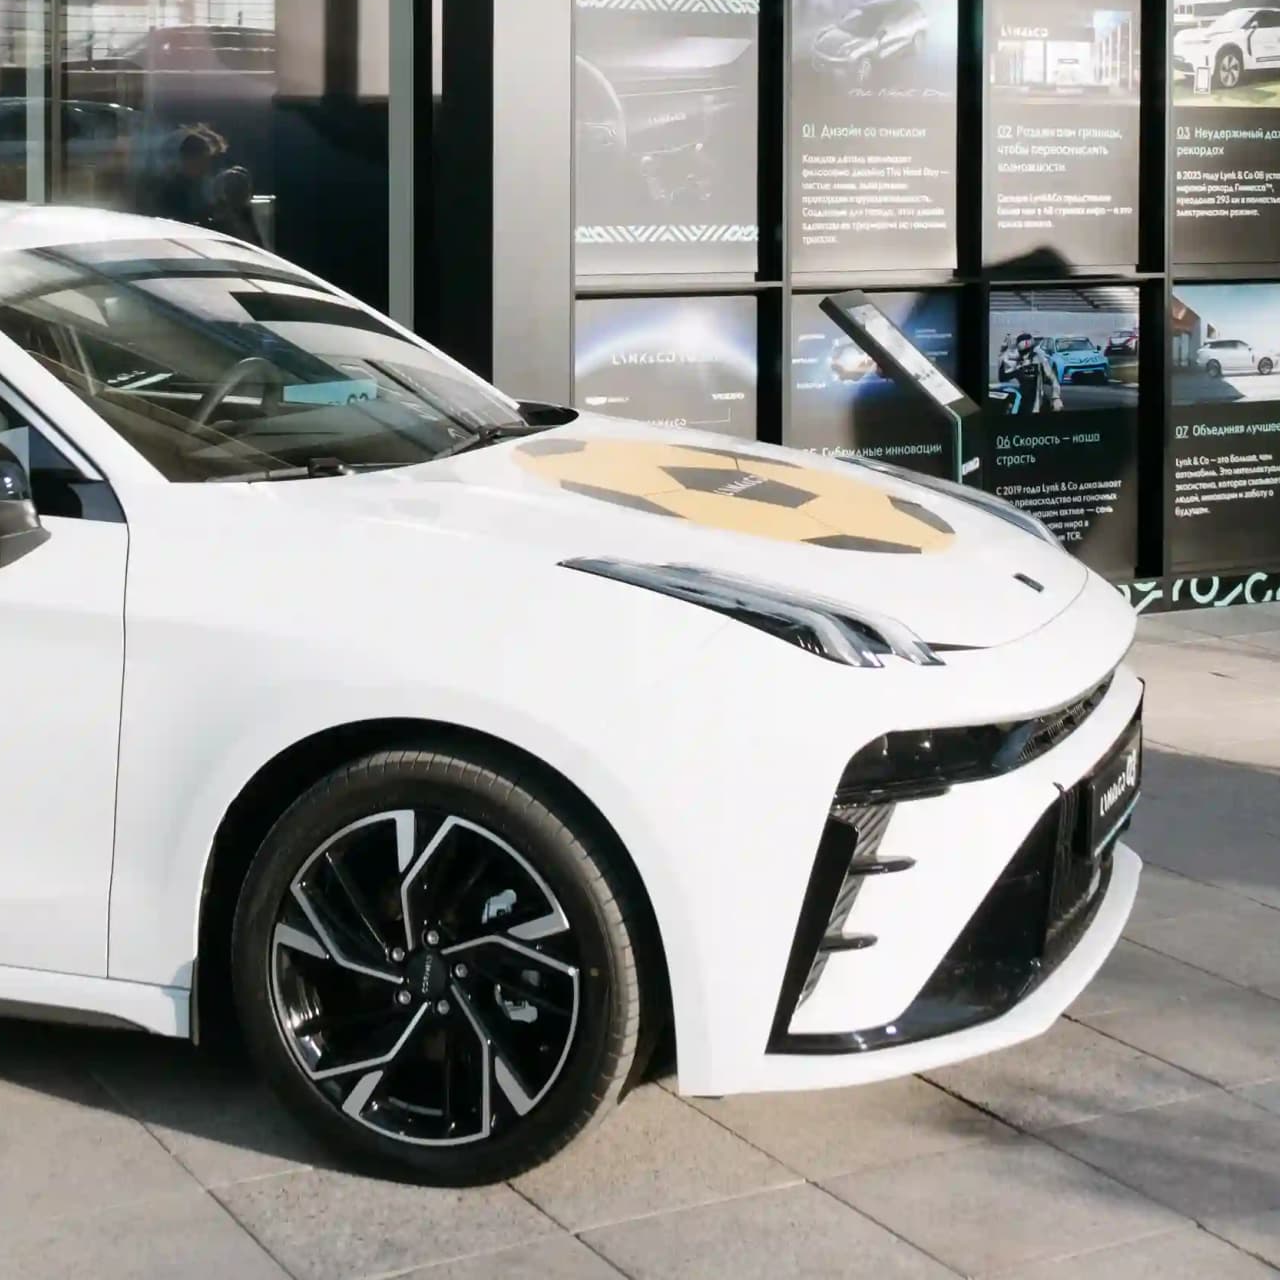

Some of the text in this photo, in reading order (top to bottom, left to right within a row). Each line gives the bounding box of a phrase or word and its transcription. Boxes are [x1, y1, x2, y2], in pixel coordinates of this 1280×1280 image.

[802, 124, 816, 137] 01
[821, 123, 862, 139] Дизайн
[864, 127, 877, 136] со
[997, 124, 1013, 138] 02
[1176, 126, 1191, 139] 03
[1194, 127, 1264, 140] Неудержимый
[997, 142, 1029, 155] чтобы
[1176, 146, 1225, 157] рекордах
[1175, 425, 1189, 438] 07
[1192, 423, 1245, 436] Объединяя
[996, 435, 1011, 448] 06
[1012, 434, 1061, 447] Скорость
[1072, 432, 1100, 442] наша
[885, 443, 942, 455] инновации
[996, 453, 1037, 466] страсть
[1175, 456, 1192, 468] Lynk
[1200, 455, 1210, 465] Co
[1003, 485, 1022, 495] 2019
[1022, 486, 1041, 494] года
[1042, 482, 1060, 494] Lynk
[1061, 481, 1067, 491] &
[1067, 481, 1078, 490] Co
[1072, 495, 1082, 503] на
